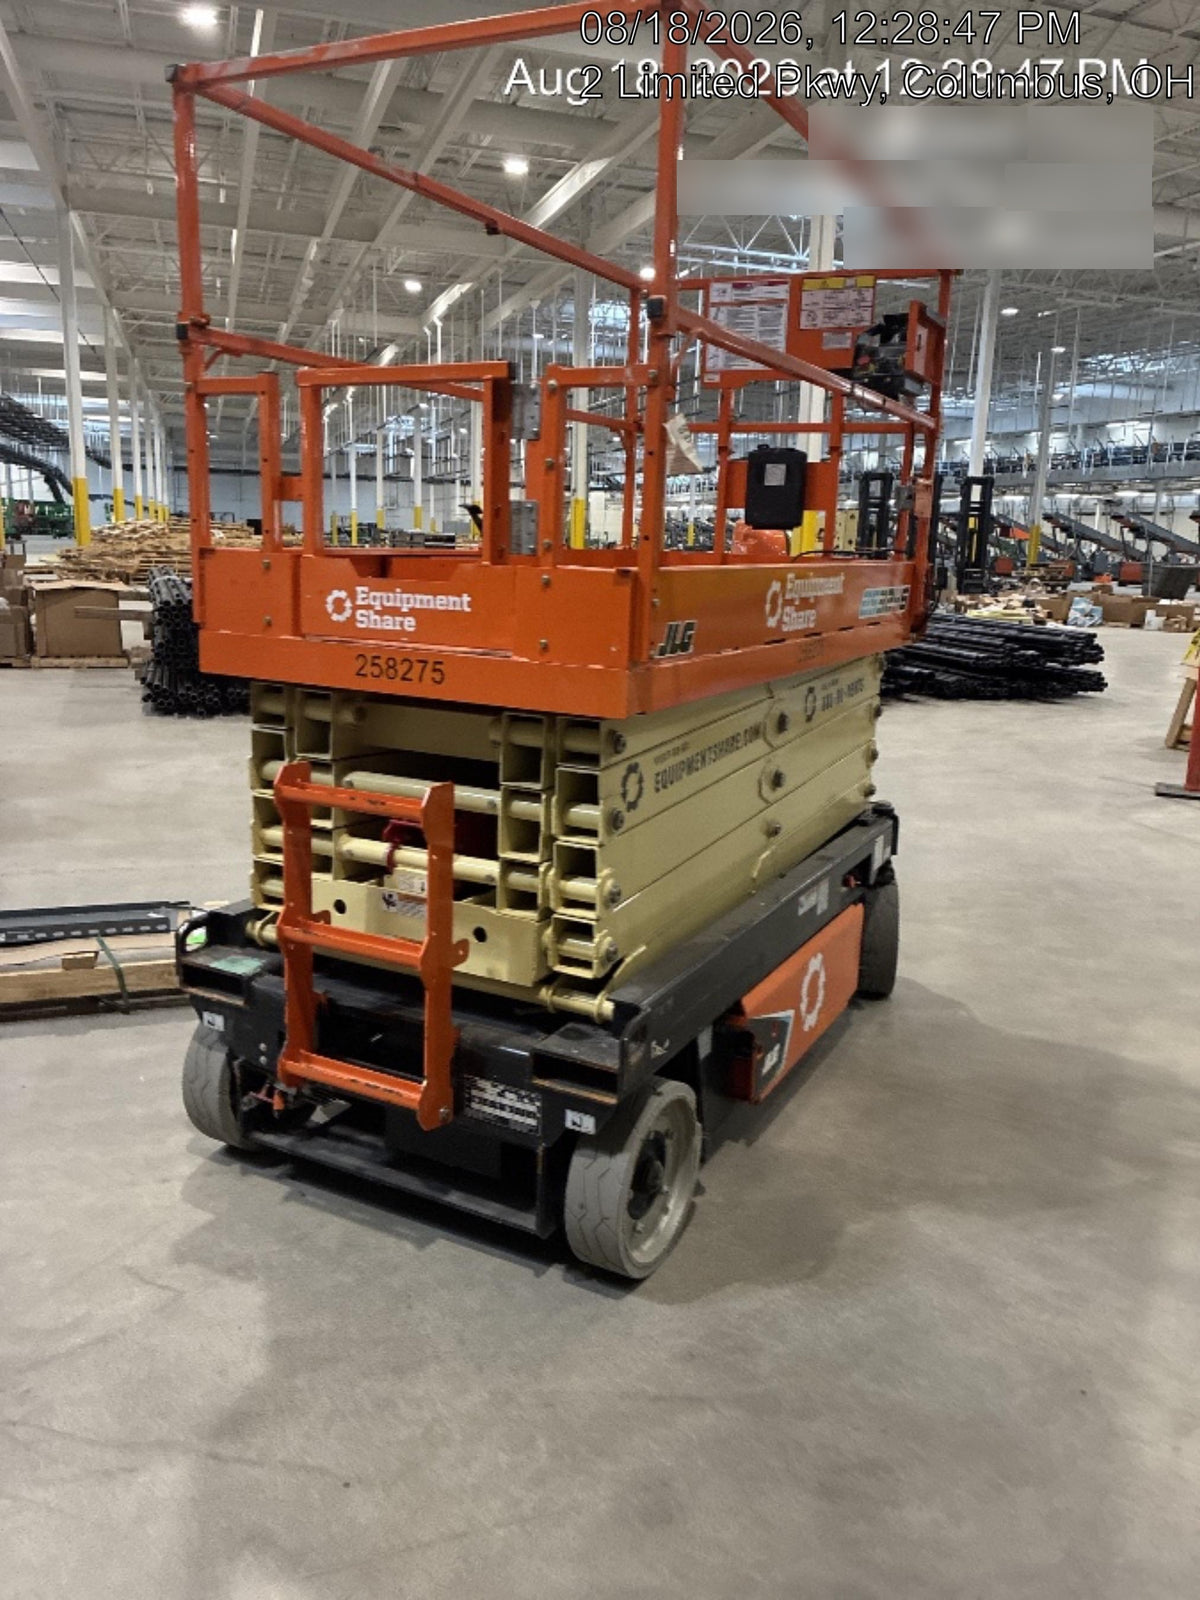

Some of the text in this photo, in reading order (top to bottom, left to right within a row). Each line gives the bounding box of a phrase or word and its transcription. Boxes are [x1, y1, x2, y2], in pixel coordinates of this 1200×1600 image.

[355, 586, 472, 612] Equipment
[355, 609, 416, 632] Share
[655, 620, 697, 658] JLG
[355, 653, 446, 685] 258275
